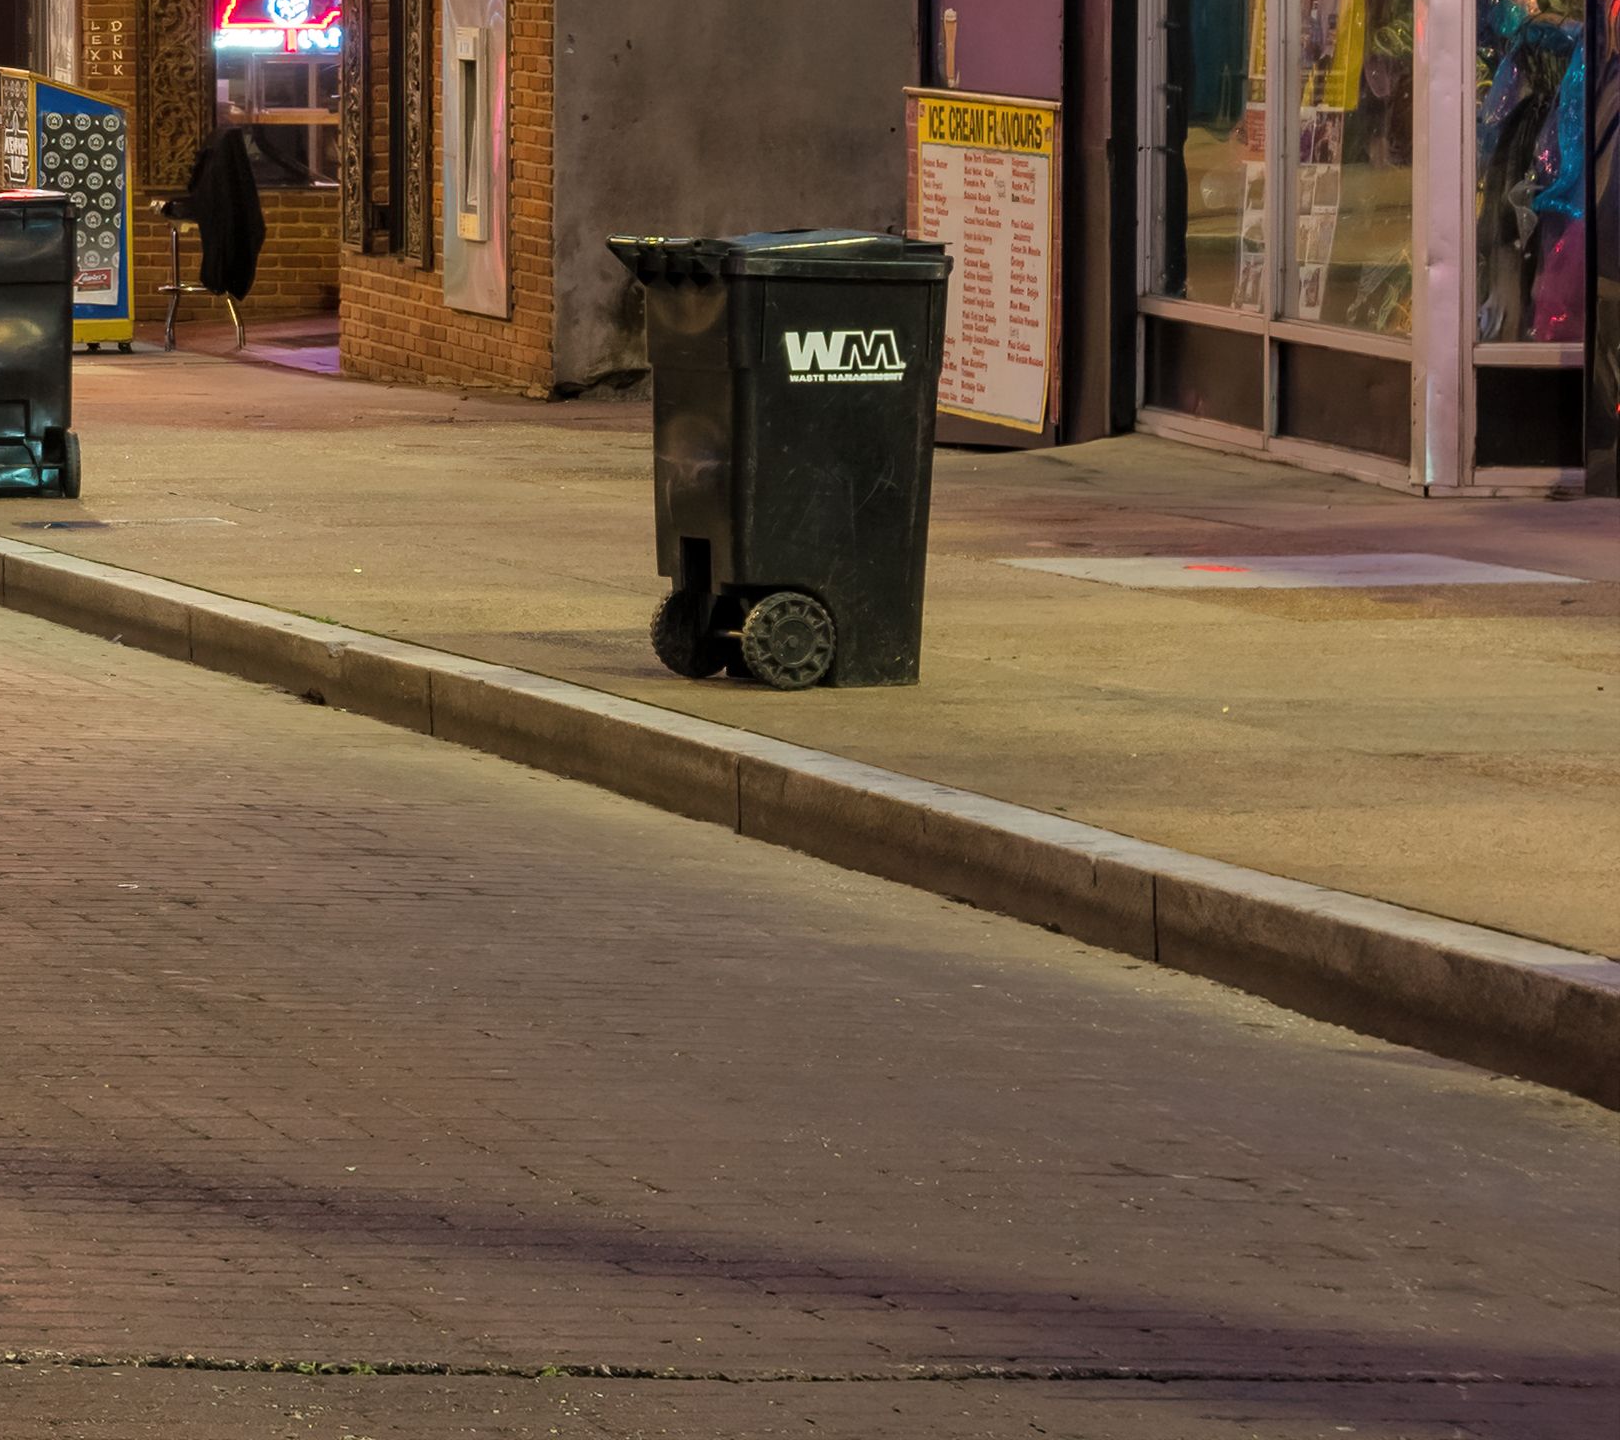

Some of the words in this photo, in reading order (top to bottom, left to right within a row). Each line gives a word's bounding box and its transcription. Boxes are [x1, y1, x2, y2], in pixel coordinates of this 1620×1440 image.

[928, 105, 945, 140] ICE
[949, 105, 985, 144] CREAM
[988, 109, 1043, 150] FLAVOURS
[785, 330, 903, 369] WM
[789, 374, 825, 383] WASTE
[827, 373, 903, 383] MANAGEMENT
